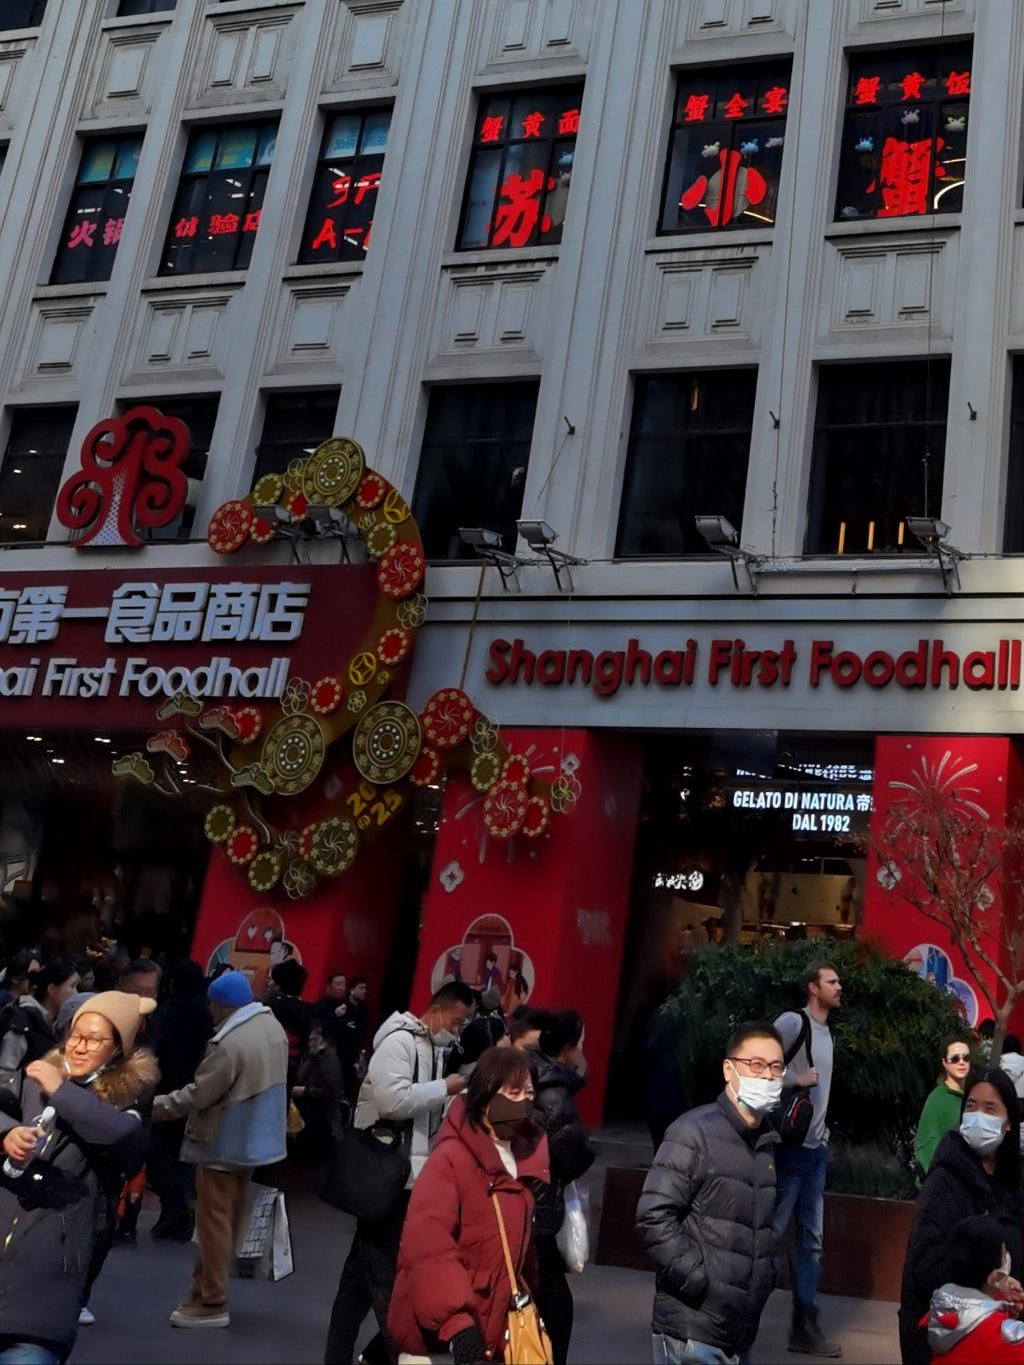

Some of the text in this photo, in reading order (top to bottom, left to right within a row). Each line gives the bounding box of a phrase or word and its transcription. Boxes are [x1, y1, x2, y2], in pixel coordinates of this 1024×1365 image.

[684, 86, 788, 122] 蟹全宴
[854, 71, 971, 105] 蟹黄饭
[480, 109, 580, 142] 蟹黄面
[681, 148, 767, 227] 小
[485, 169, 555, 247] 苏
[312, 219, 374, 250] A-
[42, 657, 117, 698] First
[118, 656, 291, 699] Foodhall
[484, 637, 1022, 696] Shanghai First Foodhall
[733, 790, 875, 812] GELATO DI NATURA 帝
[792, 814, 850, 832] DAL 1982
